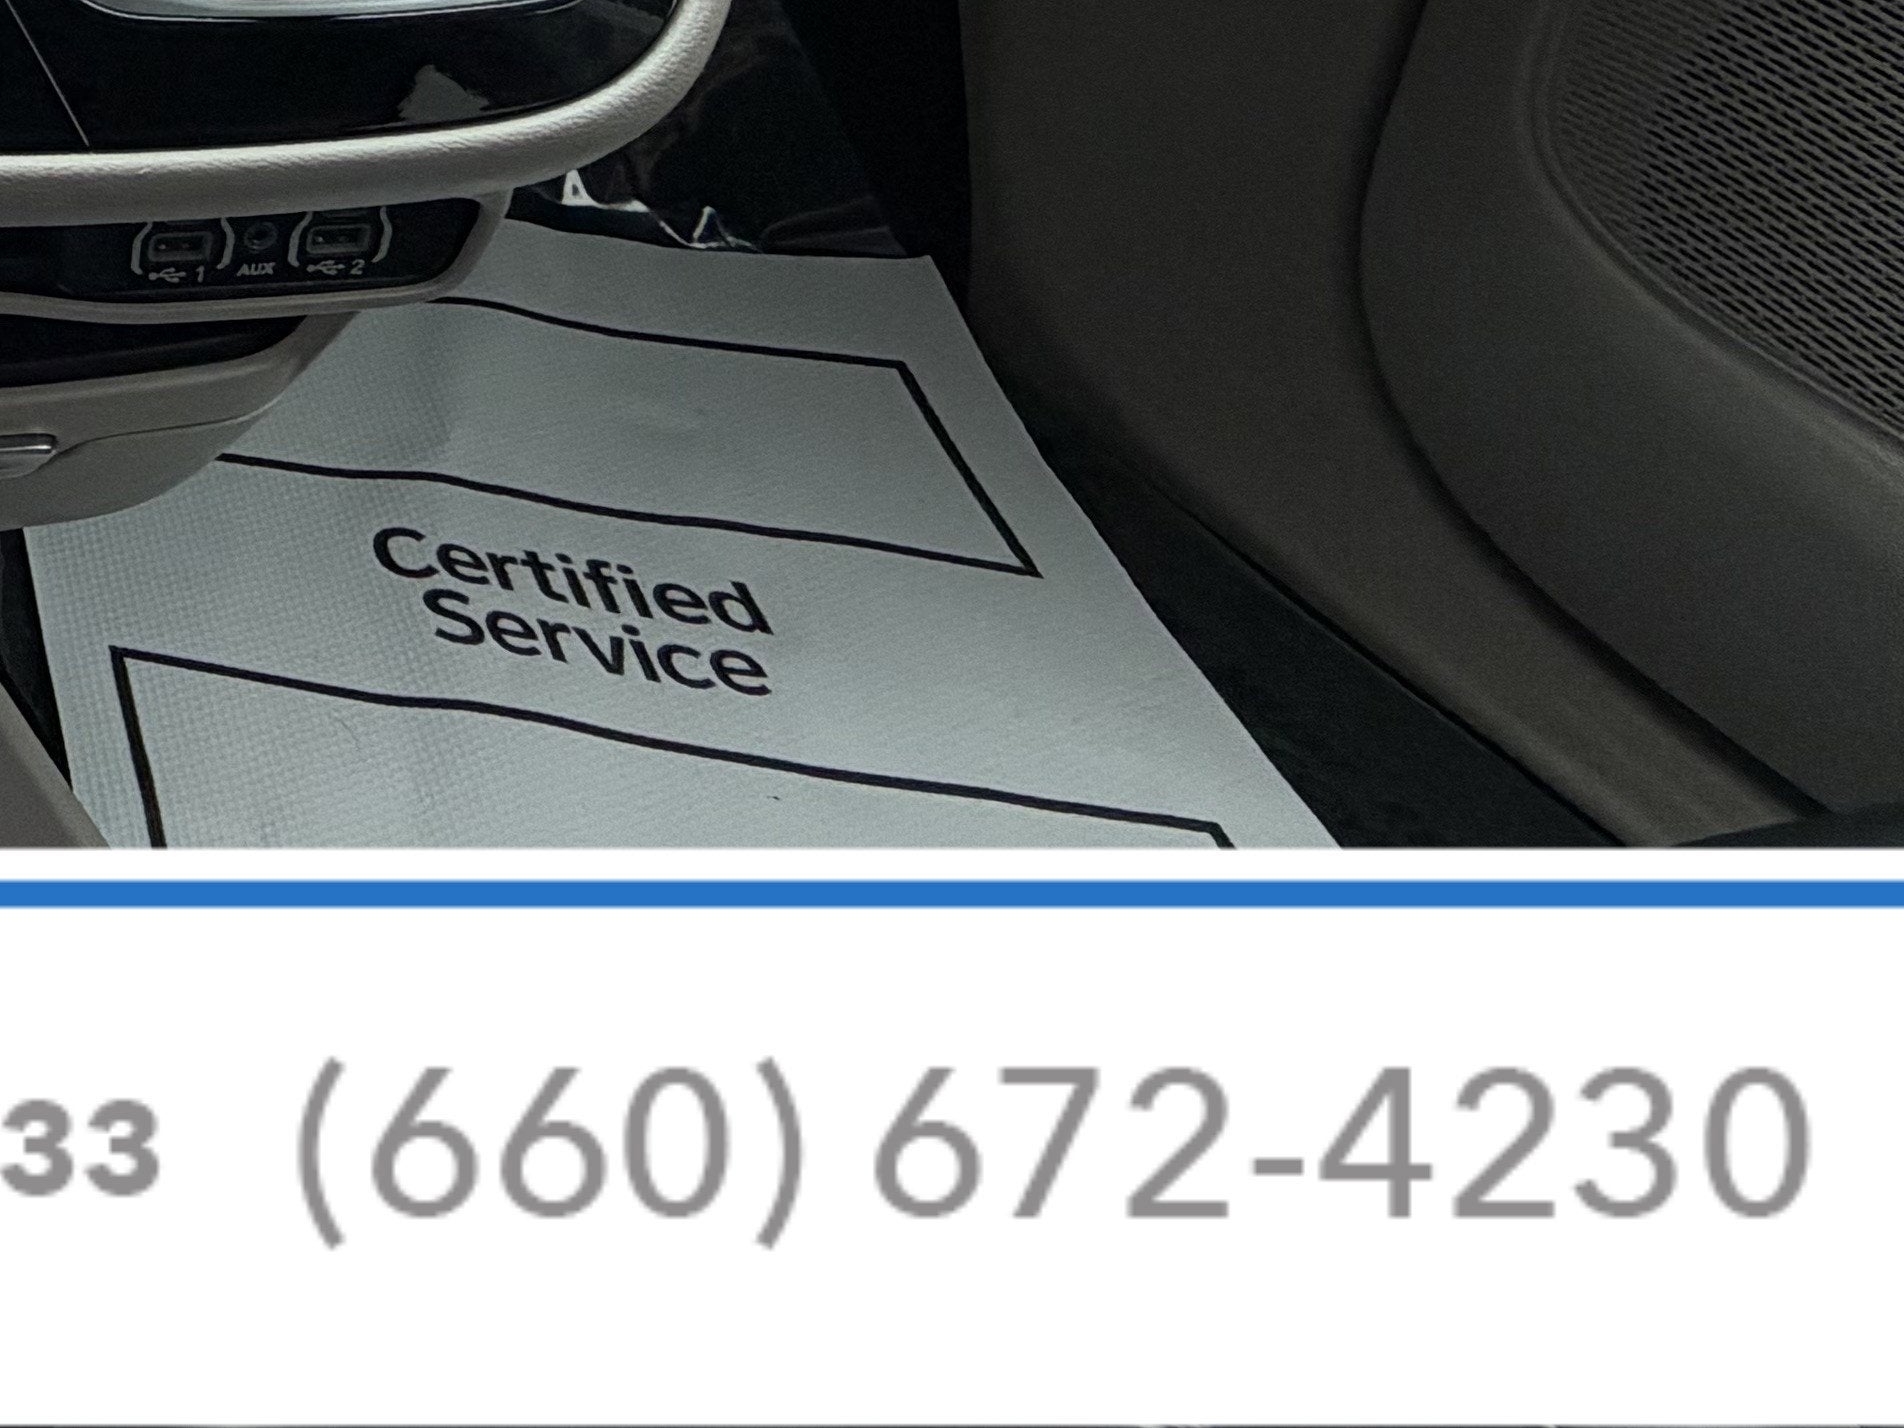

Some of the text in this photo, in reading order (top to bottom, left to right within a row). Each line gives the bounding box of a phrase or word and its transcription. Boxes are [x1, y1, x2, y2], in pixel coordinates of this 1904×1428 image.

[196, 267, 205, 283] 1
[237, 261, 276, 277] AUX
[350, 260, 364, 276] 2
[372, 526, 774, 636] Certified
[421, 588, 772, 696] Service
